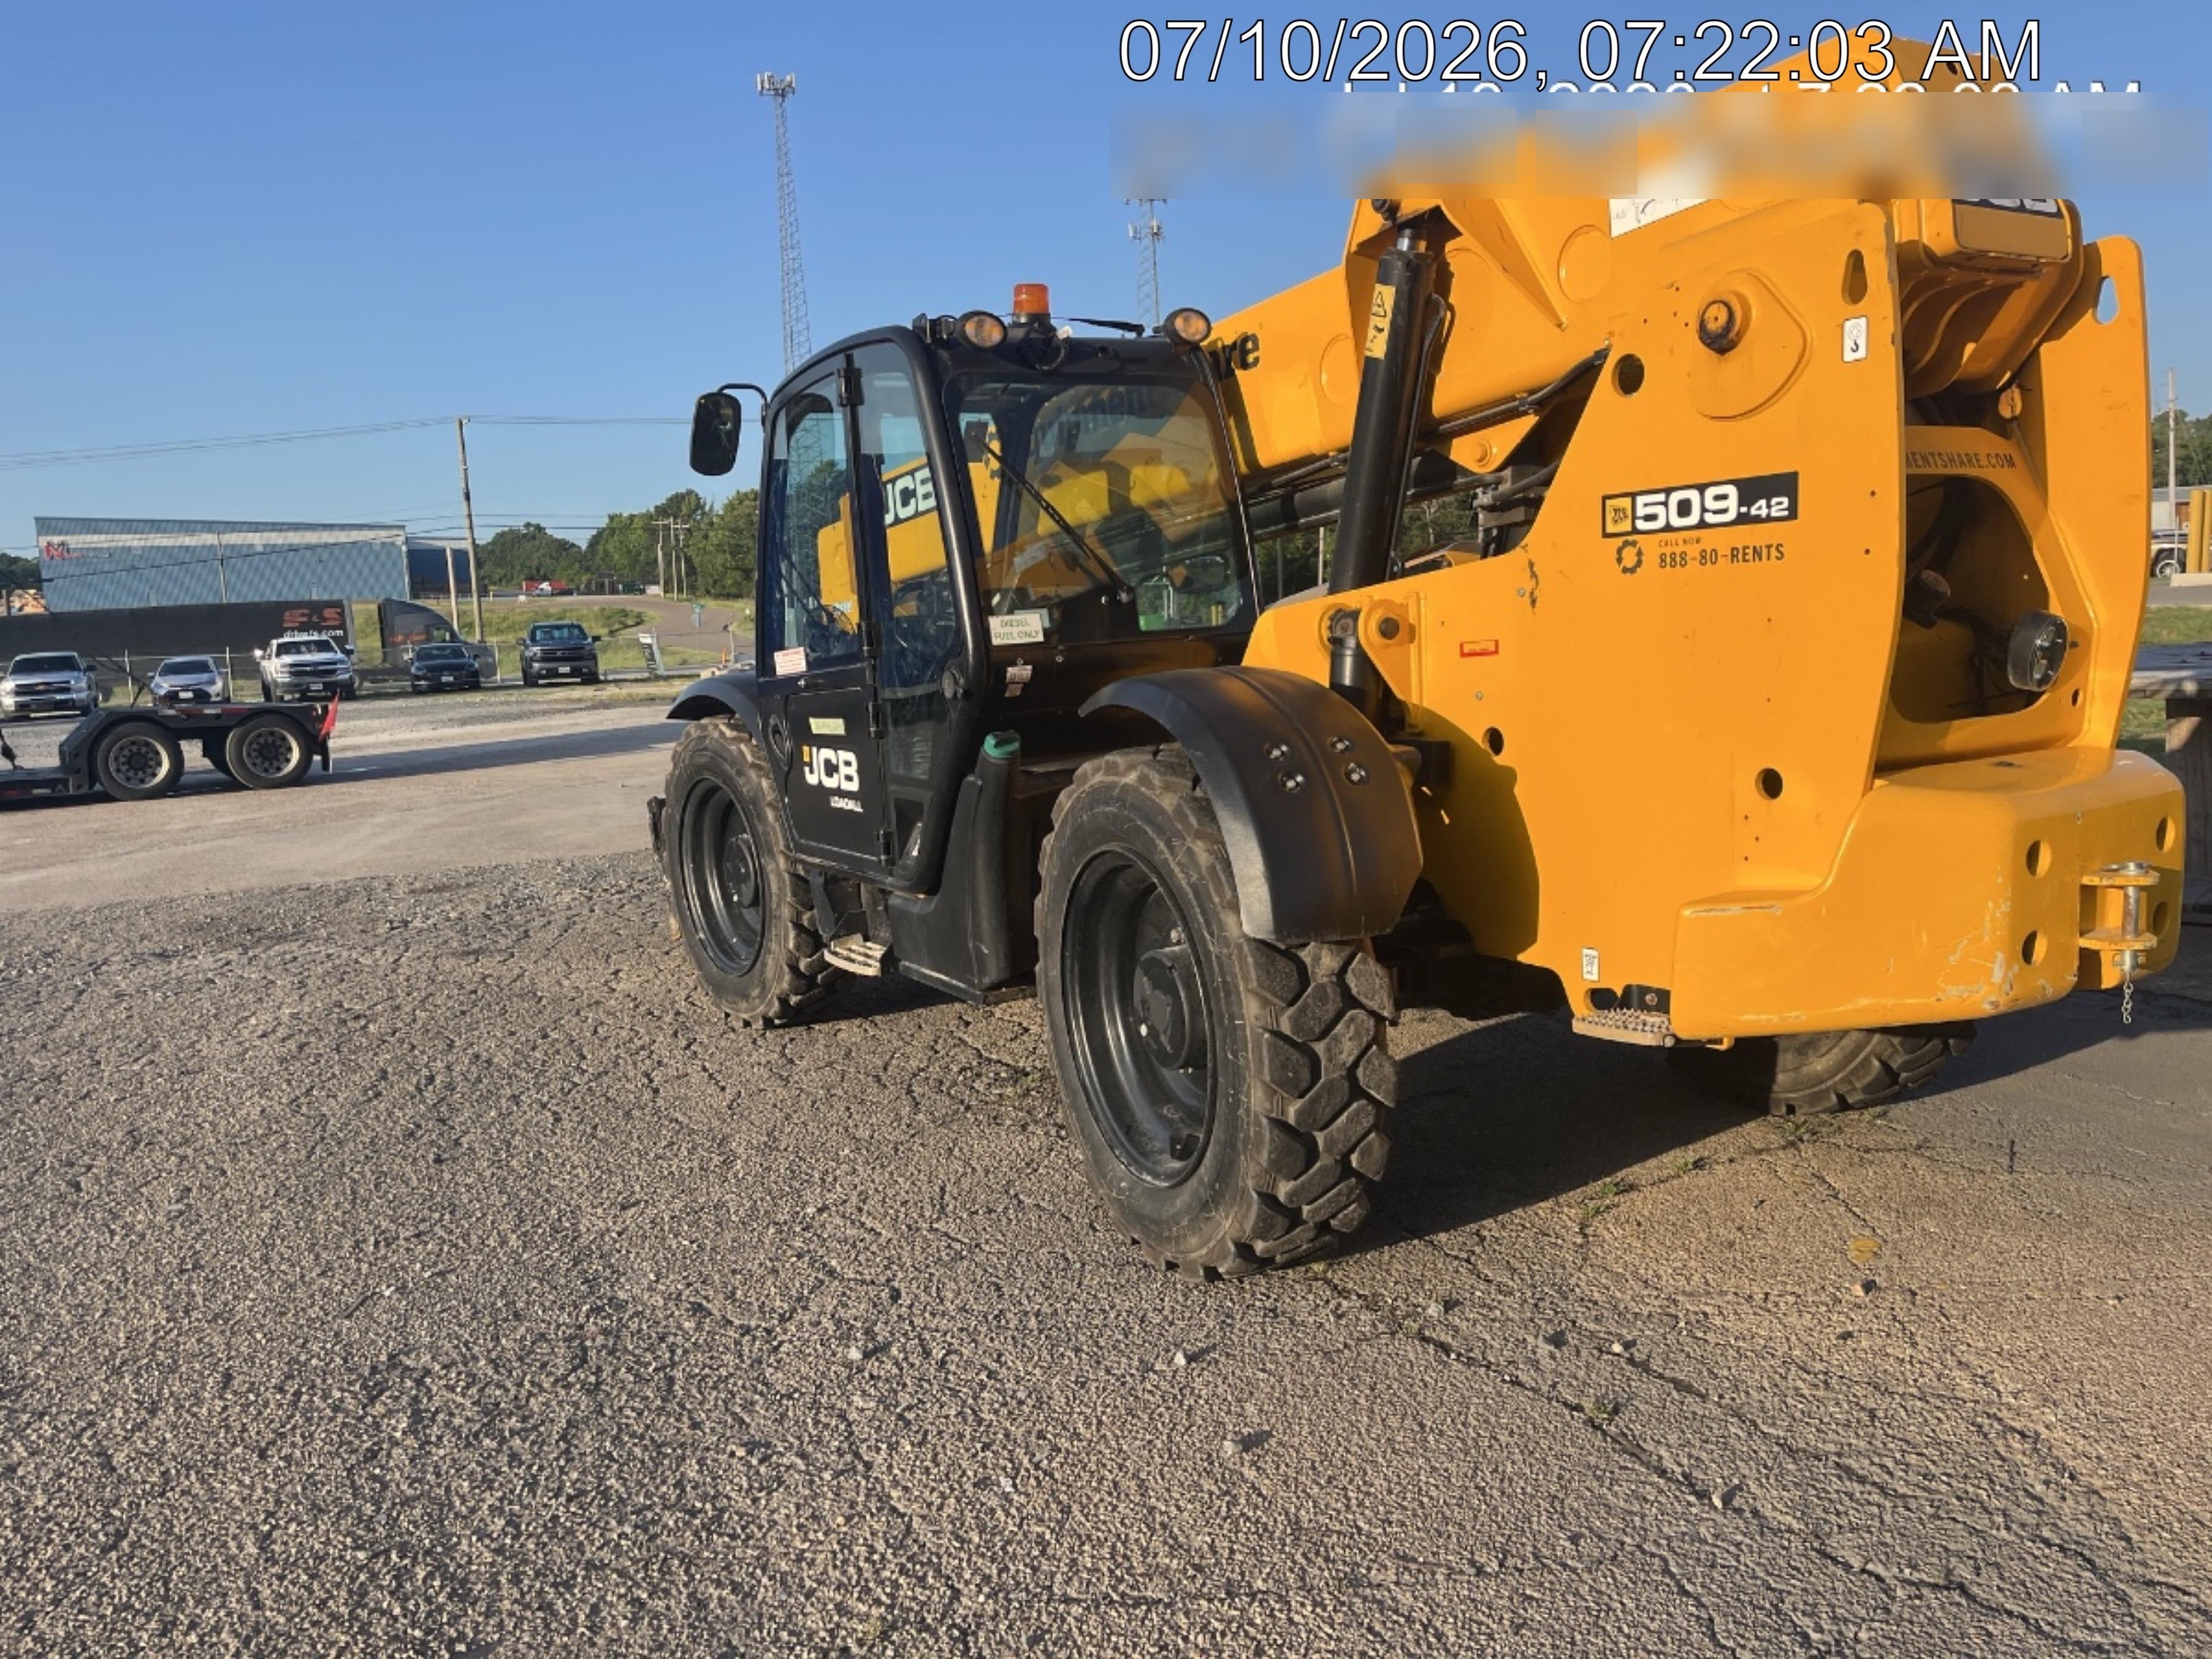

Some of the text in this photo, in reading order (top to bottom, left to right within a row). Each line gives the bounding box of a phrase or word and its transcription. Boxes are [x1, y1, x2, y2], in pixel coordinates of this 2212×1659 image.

[1634, 484, 1789, 531] 509-42
[1659, 543, 1785, 568] 888-80-RENTS
[1000, 618, 1032, 628] DIESEL
[1017, 629, 1040, 639] ONLY
[803, 745, 860, 792] JCB
